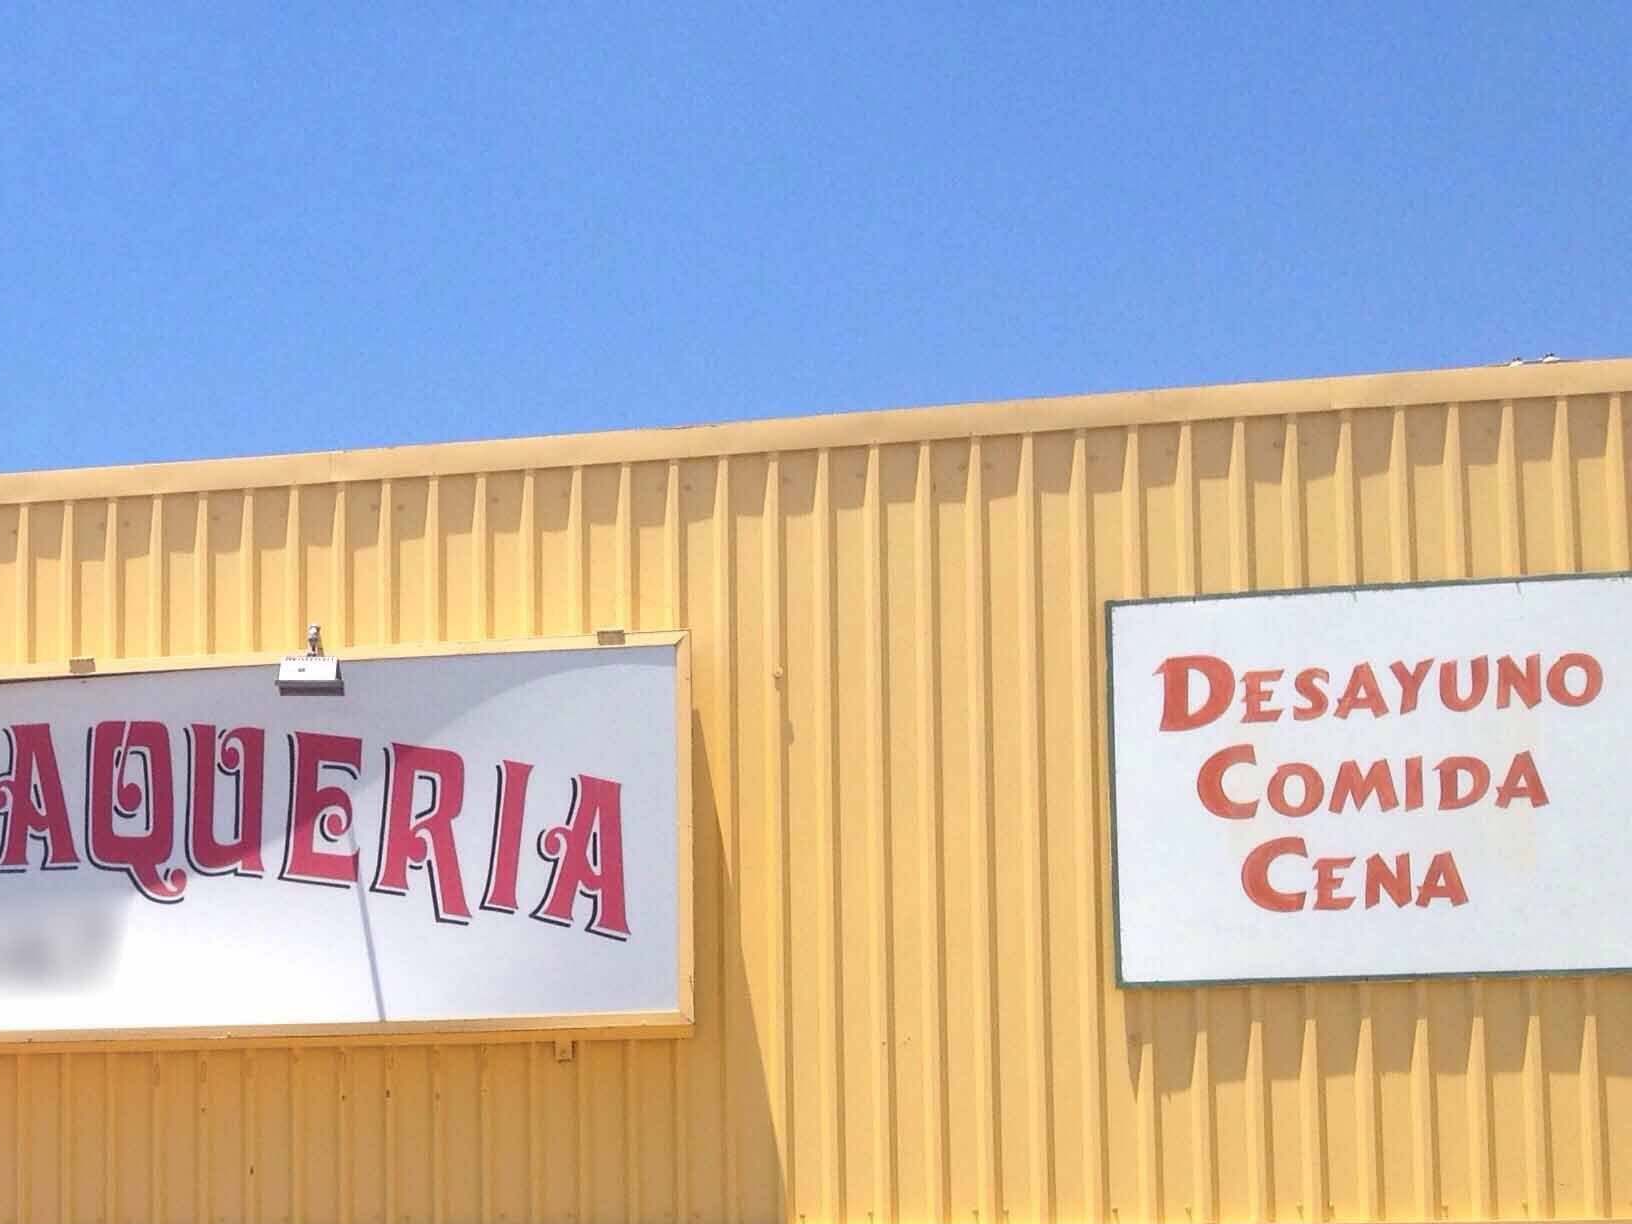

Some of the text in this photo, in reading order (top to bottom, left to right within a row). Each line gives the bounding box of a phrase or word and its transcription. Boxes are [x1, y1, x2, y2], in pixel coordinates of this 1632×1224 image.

[1152, 652, 1604, 732] DESAYUNO
[1196, 743, 1550, 819] COMIDA
[1241, 836, 1469, 912] CENA
